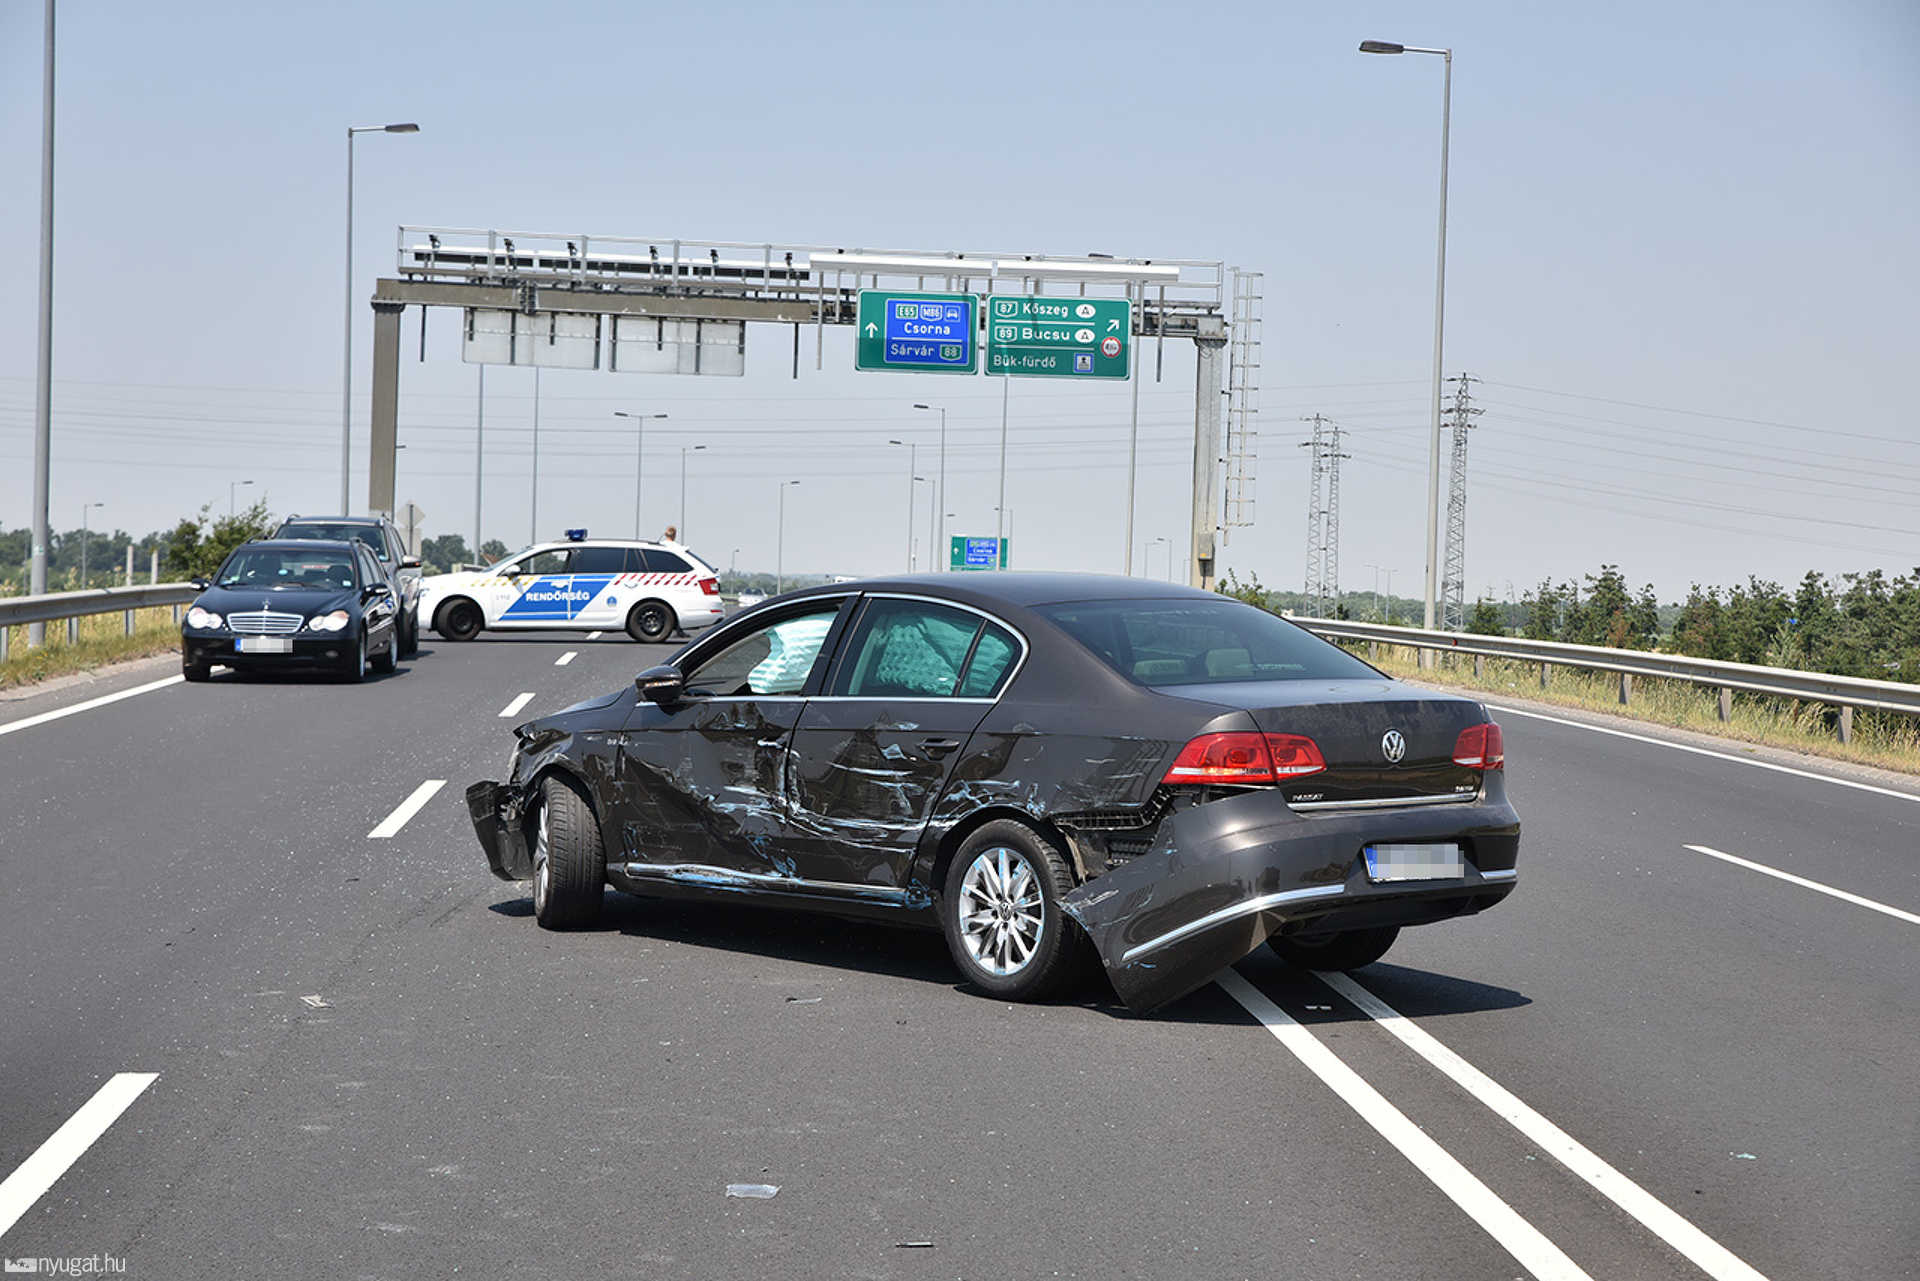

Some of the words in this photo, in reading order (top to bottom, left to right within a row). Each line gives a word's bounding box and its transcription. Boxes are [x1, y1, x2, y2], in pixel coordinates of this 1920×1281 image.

[1000, 303, 1013, 314] 87
[1022, 302, 1069, 318] Kőszeg
[904, 321, 951, 335] Csorna
[1022, 327, 1070, 341] Bucsu
[890, 343, 935, 357] Sárvár
[525, 590, 590, 601] RENDŐRSÉG
